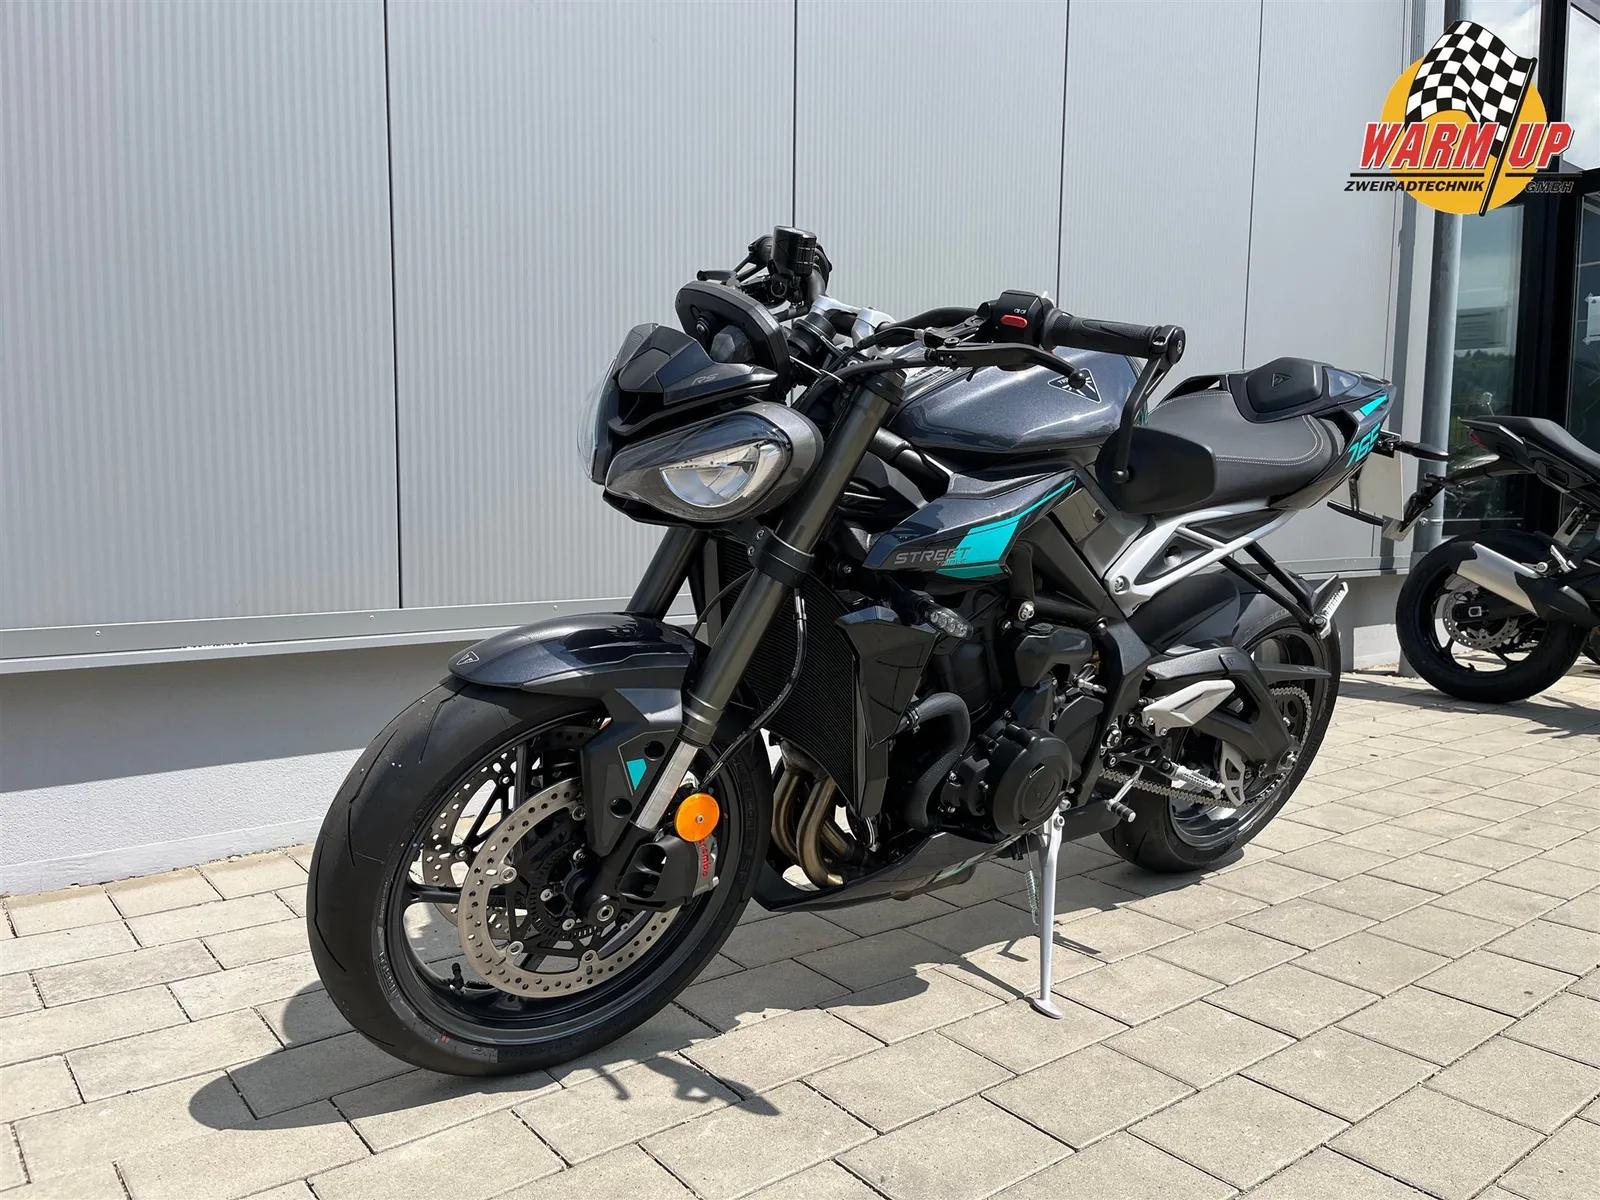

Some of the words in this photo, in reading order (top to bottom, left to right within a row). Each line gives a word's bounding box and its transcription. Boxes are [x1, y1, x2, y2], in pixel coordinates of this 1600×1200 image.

[691, 373, 719, 386] RS
[894, 546, 972, 565] STREET
[699, 838, 711, 878] rembo
